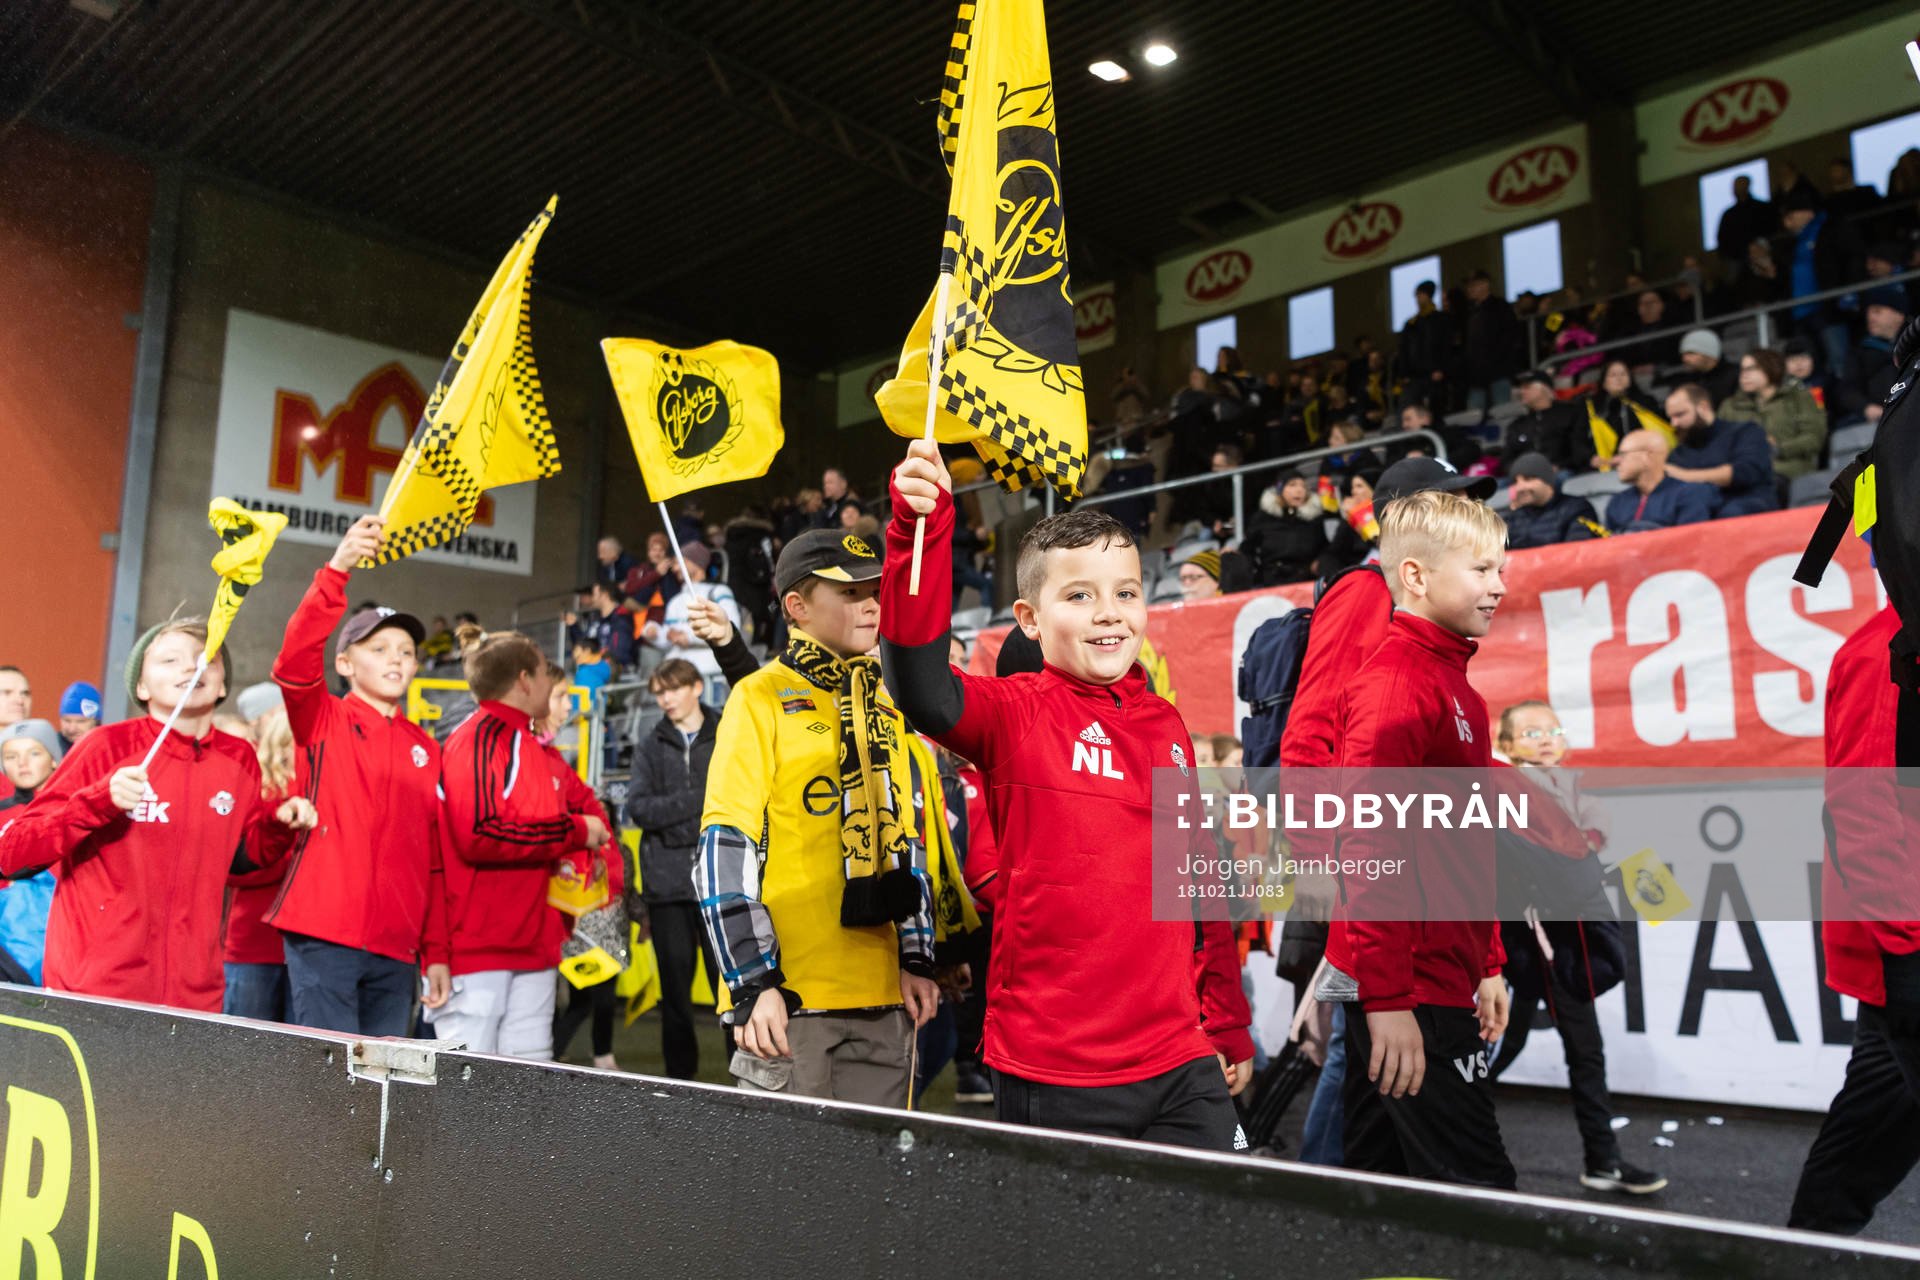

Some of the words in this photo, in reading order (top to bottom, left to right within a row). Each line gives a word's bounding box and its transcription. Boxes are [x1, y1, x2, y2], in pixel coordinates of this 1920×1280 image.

[1690, 83, 1779, 140] AXA
[1495, 152, 1570, 199] AXA
[1330, 206, 1396, 251] AXA
[1192, 254, 1246, 297] AXA
[661, 384, 720, 453] Elfsborg
[268, 360, 495, 527] MA
[431, 531, 519, 564] VENSKA
[1540, 552, 1887, 749] ras
[1071, 741, 1124, 780] NL
[1079, 732, 1112, 746] adidas
[1453, 1050, 1489, 1083] VS
